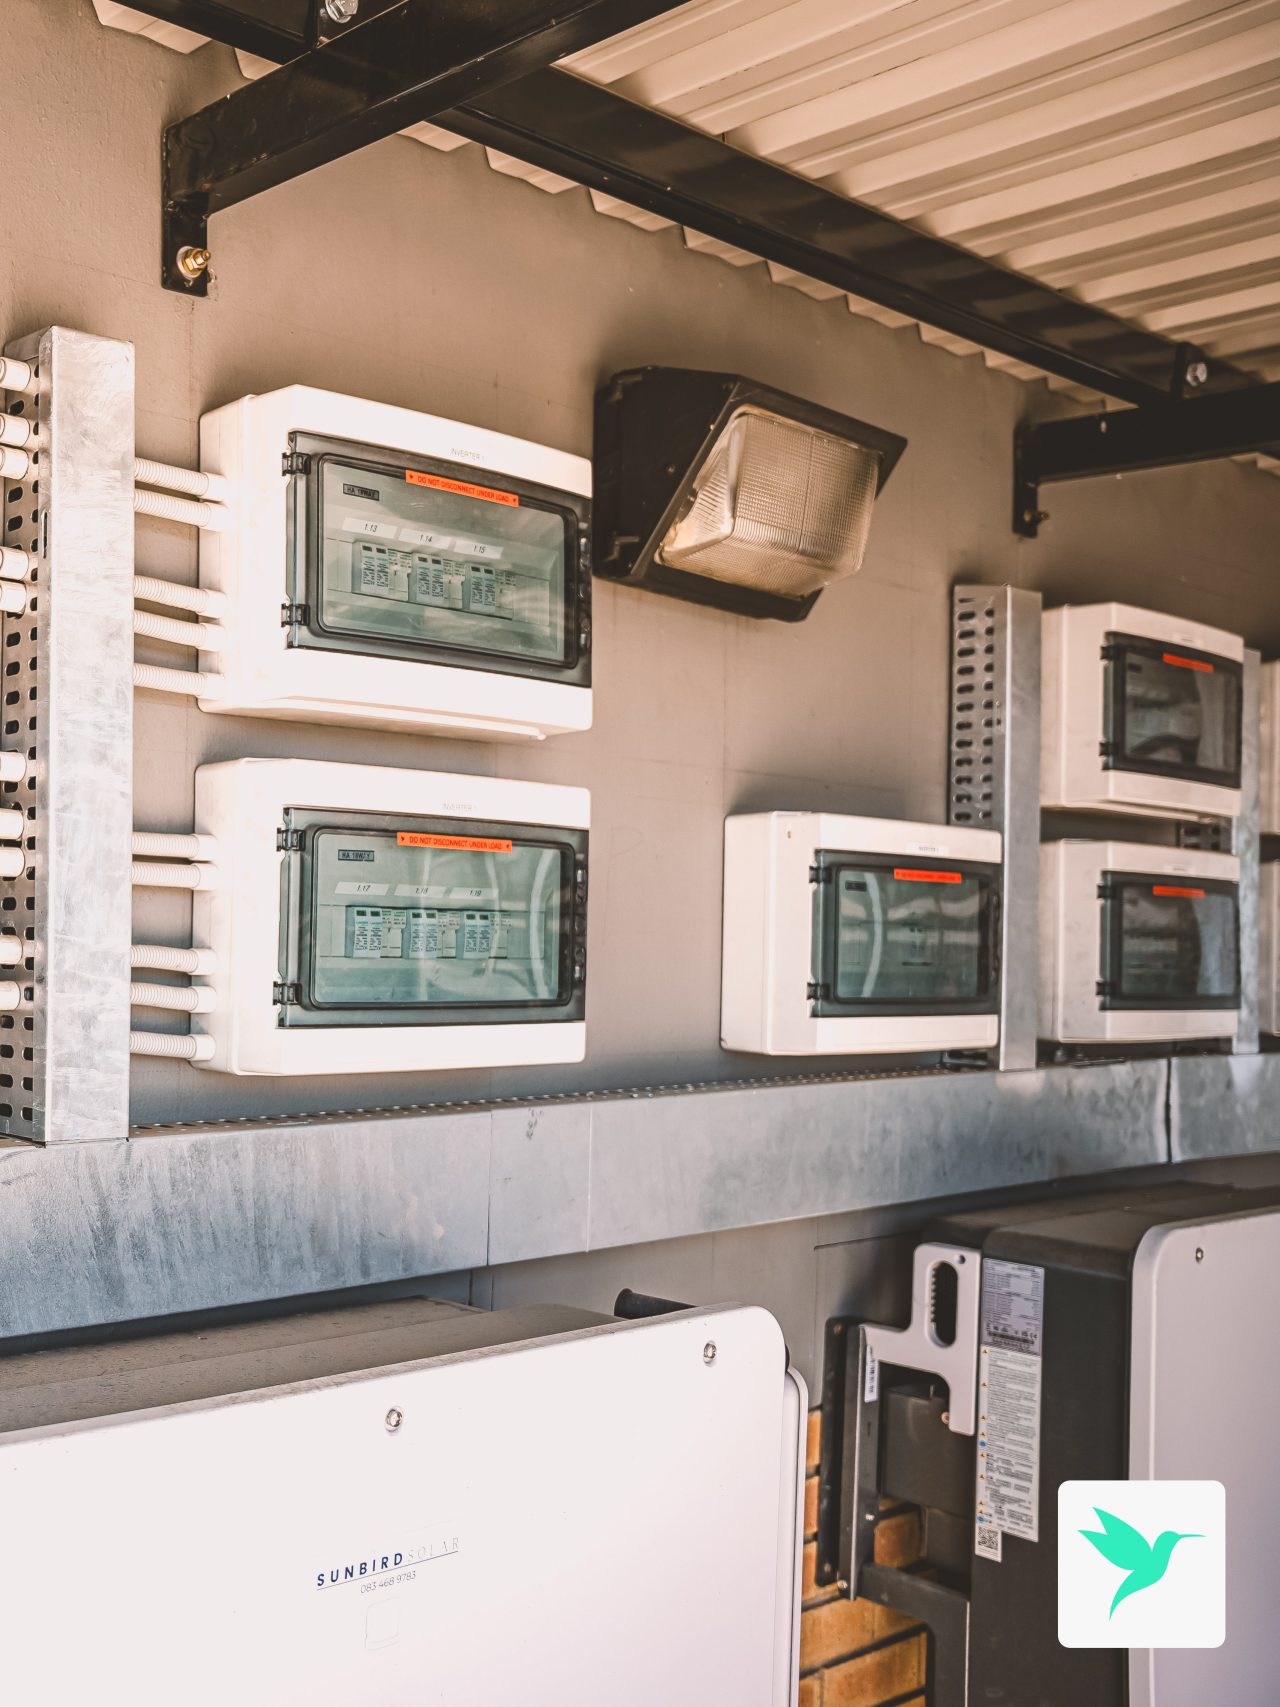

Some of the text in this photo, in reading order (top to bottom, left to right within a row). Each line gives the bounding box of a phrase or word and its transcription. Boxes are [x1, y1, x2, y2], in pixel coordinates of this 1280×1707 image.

[417, 475, 509, 502] DO NOT DISCONNECT UNDER LOAD
[364, 523, 378, 533] 1.13
[419, 534, 433, 543] 1.14
[433, 838, 468, 848] DISCONNECT
[469, 841, 487, 849] UNDER
[488, 842, 502, 850] LOAD
[316, 1553, 403, 1586] SUNBIRD
[360, 1570, 416, 1594] 083 468 9783
